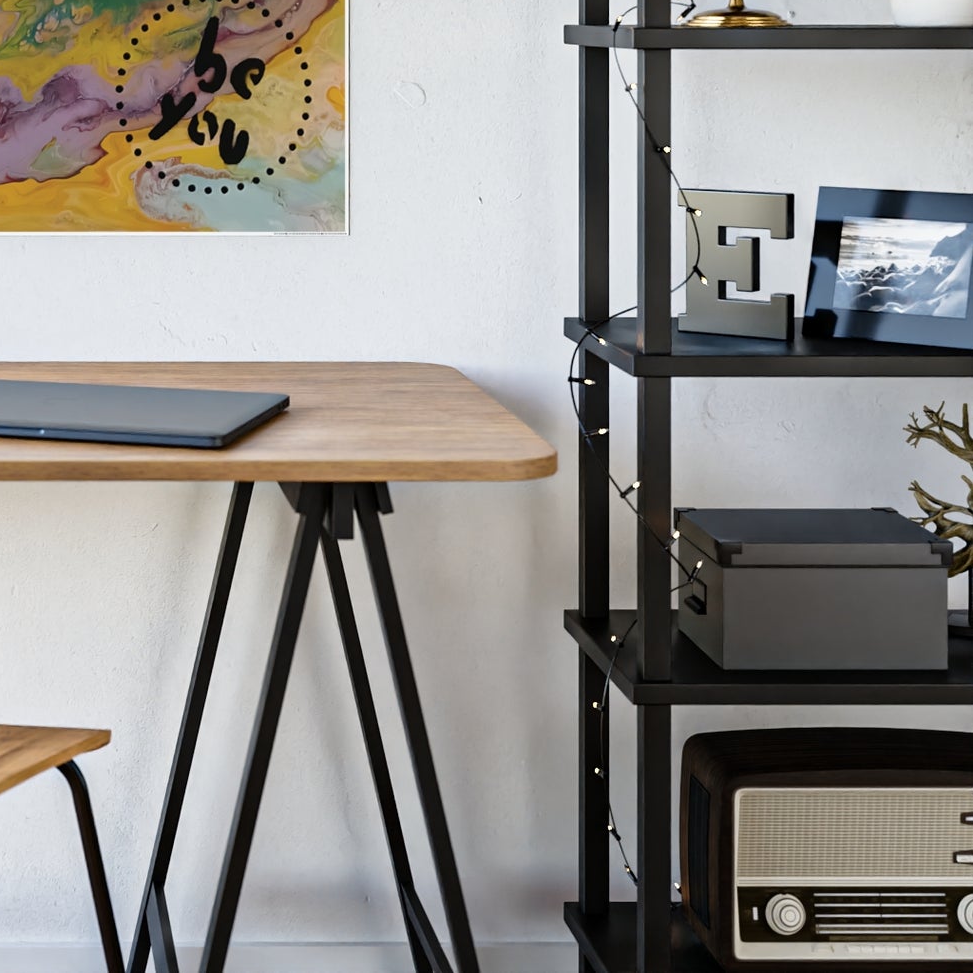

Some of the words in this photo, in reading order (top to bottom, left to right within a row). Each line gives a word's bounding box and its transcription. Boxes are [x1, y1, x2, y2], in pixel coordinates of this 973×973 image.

[194, 16, 265, 100] be
[148, 92, 249, 164] you
[678, 188, 794, 340] E
